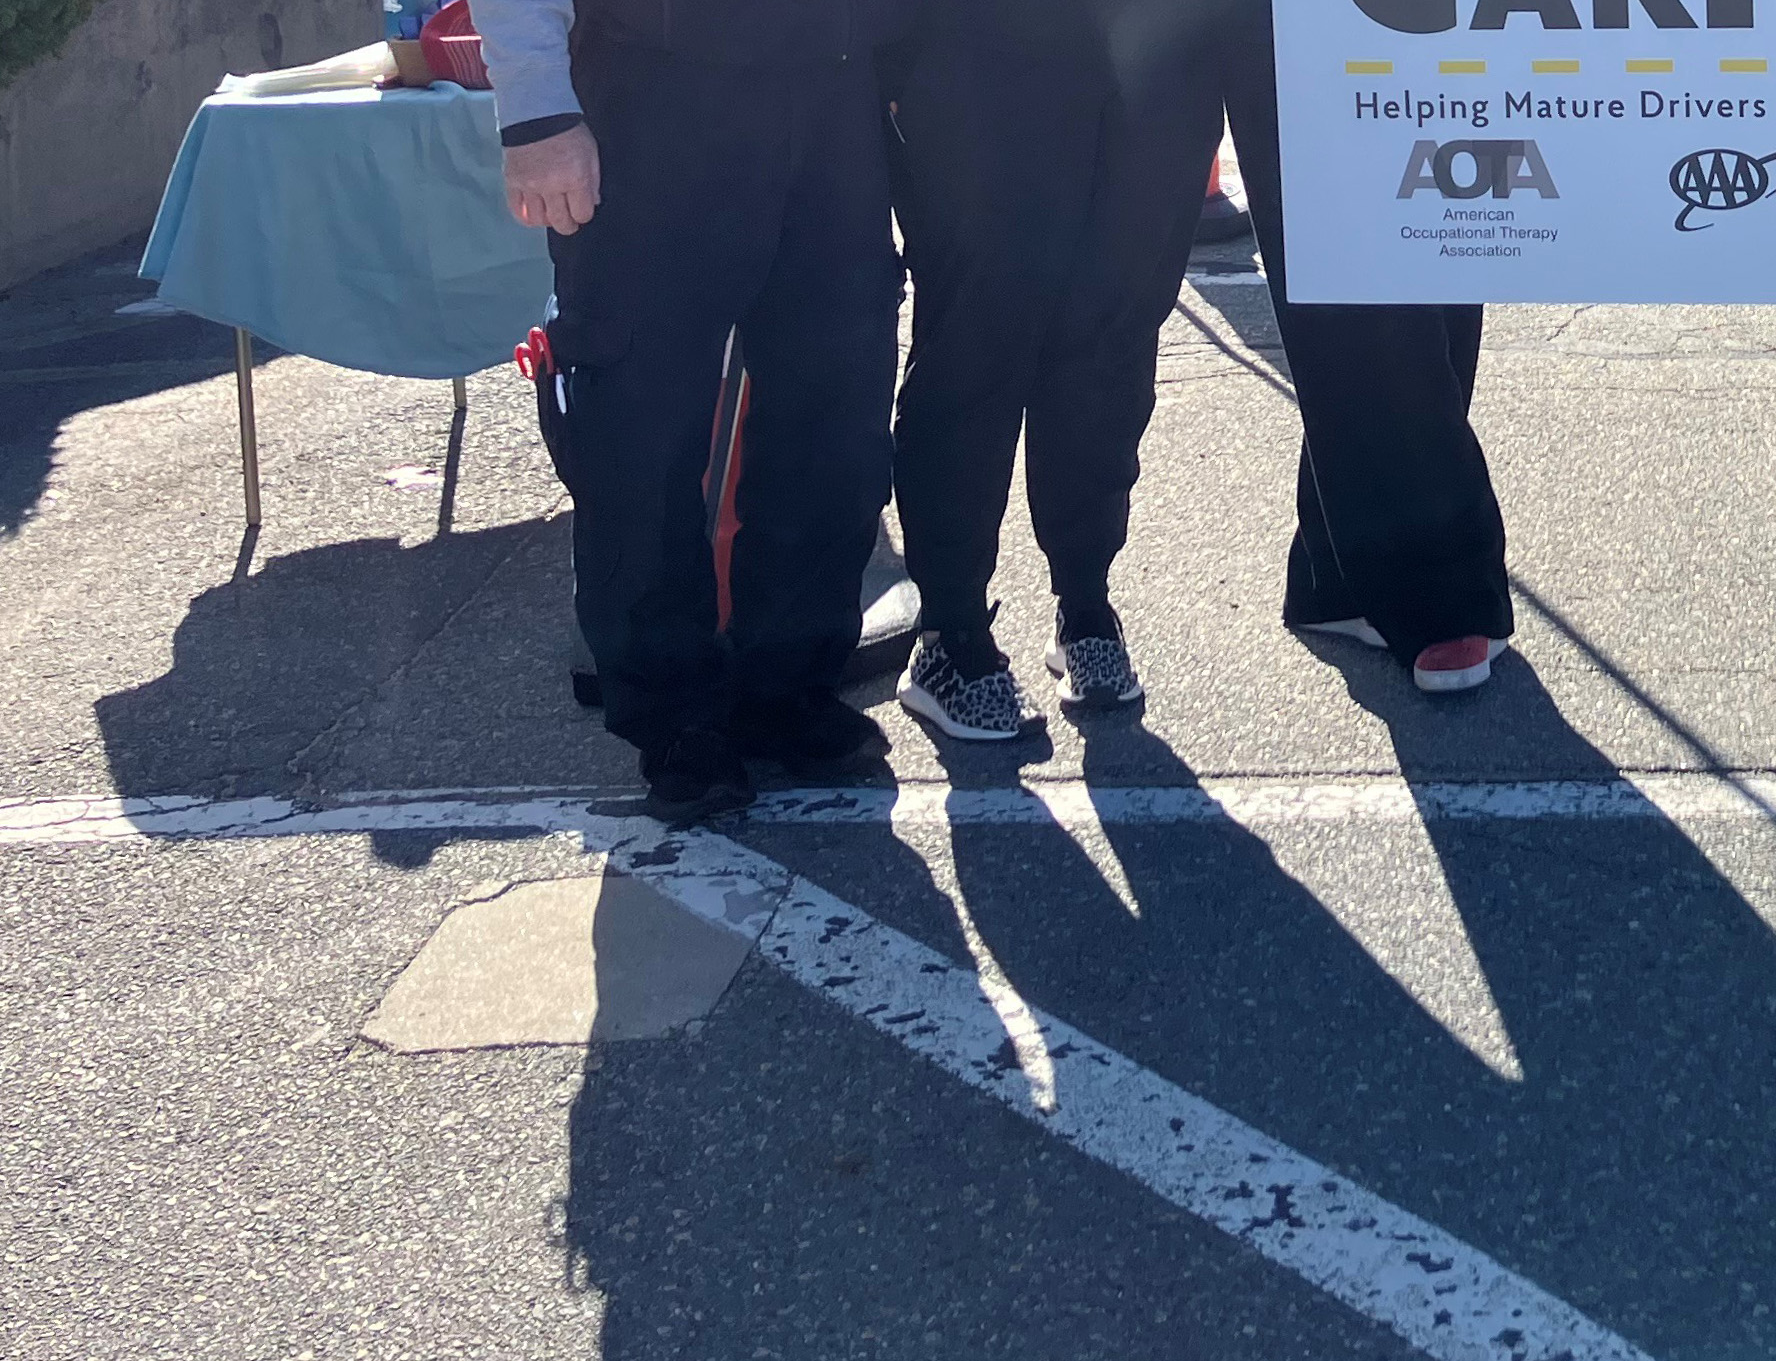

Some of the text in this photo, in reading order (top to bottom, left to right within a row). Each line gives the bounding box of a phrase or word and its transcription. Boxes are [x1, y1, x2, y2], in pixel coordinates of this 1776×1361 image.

[1355, 89, 1489, 127] Helping
[1505, 91, 1625, 119] Mature
[1641, 90, 1766, 119] Drivers
[1396, 139, 1560, 199] AOTA
[1674, 150, 1764, 209] AAA
[1443, 208, 1514, 221] American
[1400, 226, 1558, 242] Occupational Therapy
[1439, 244, 1521, 257] Association
